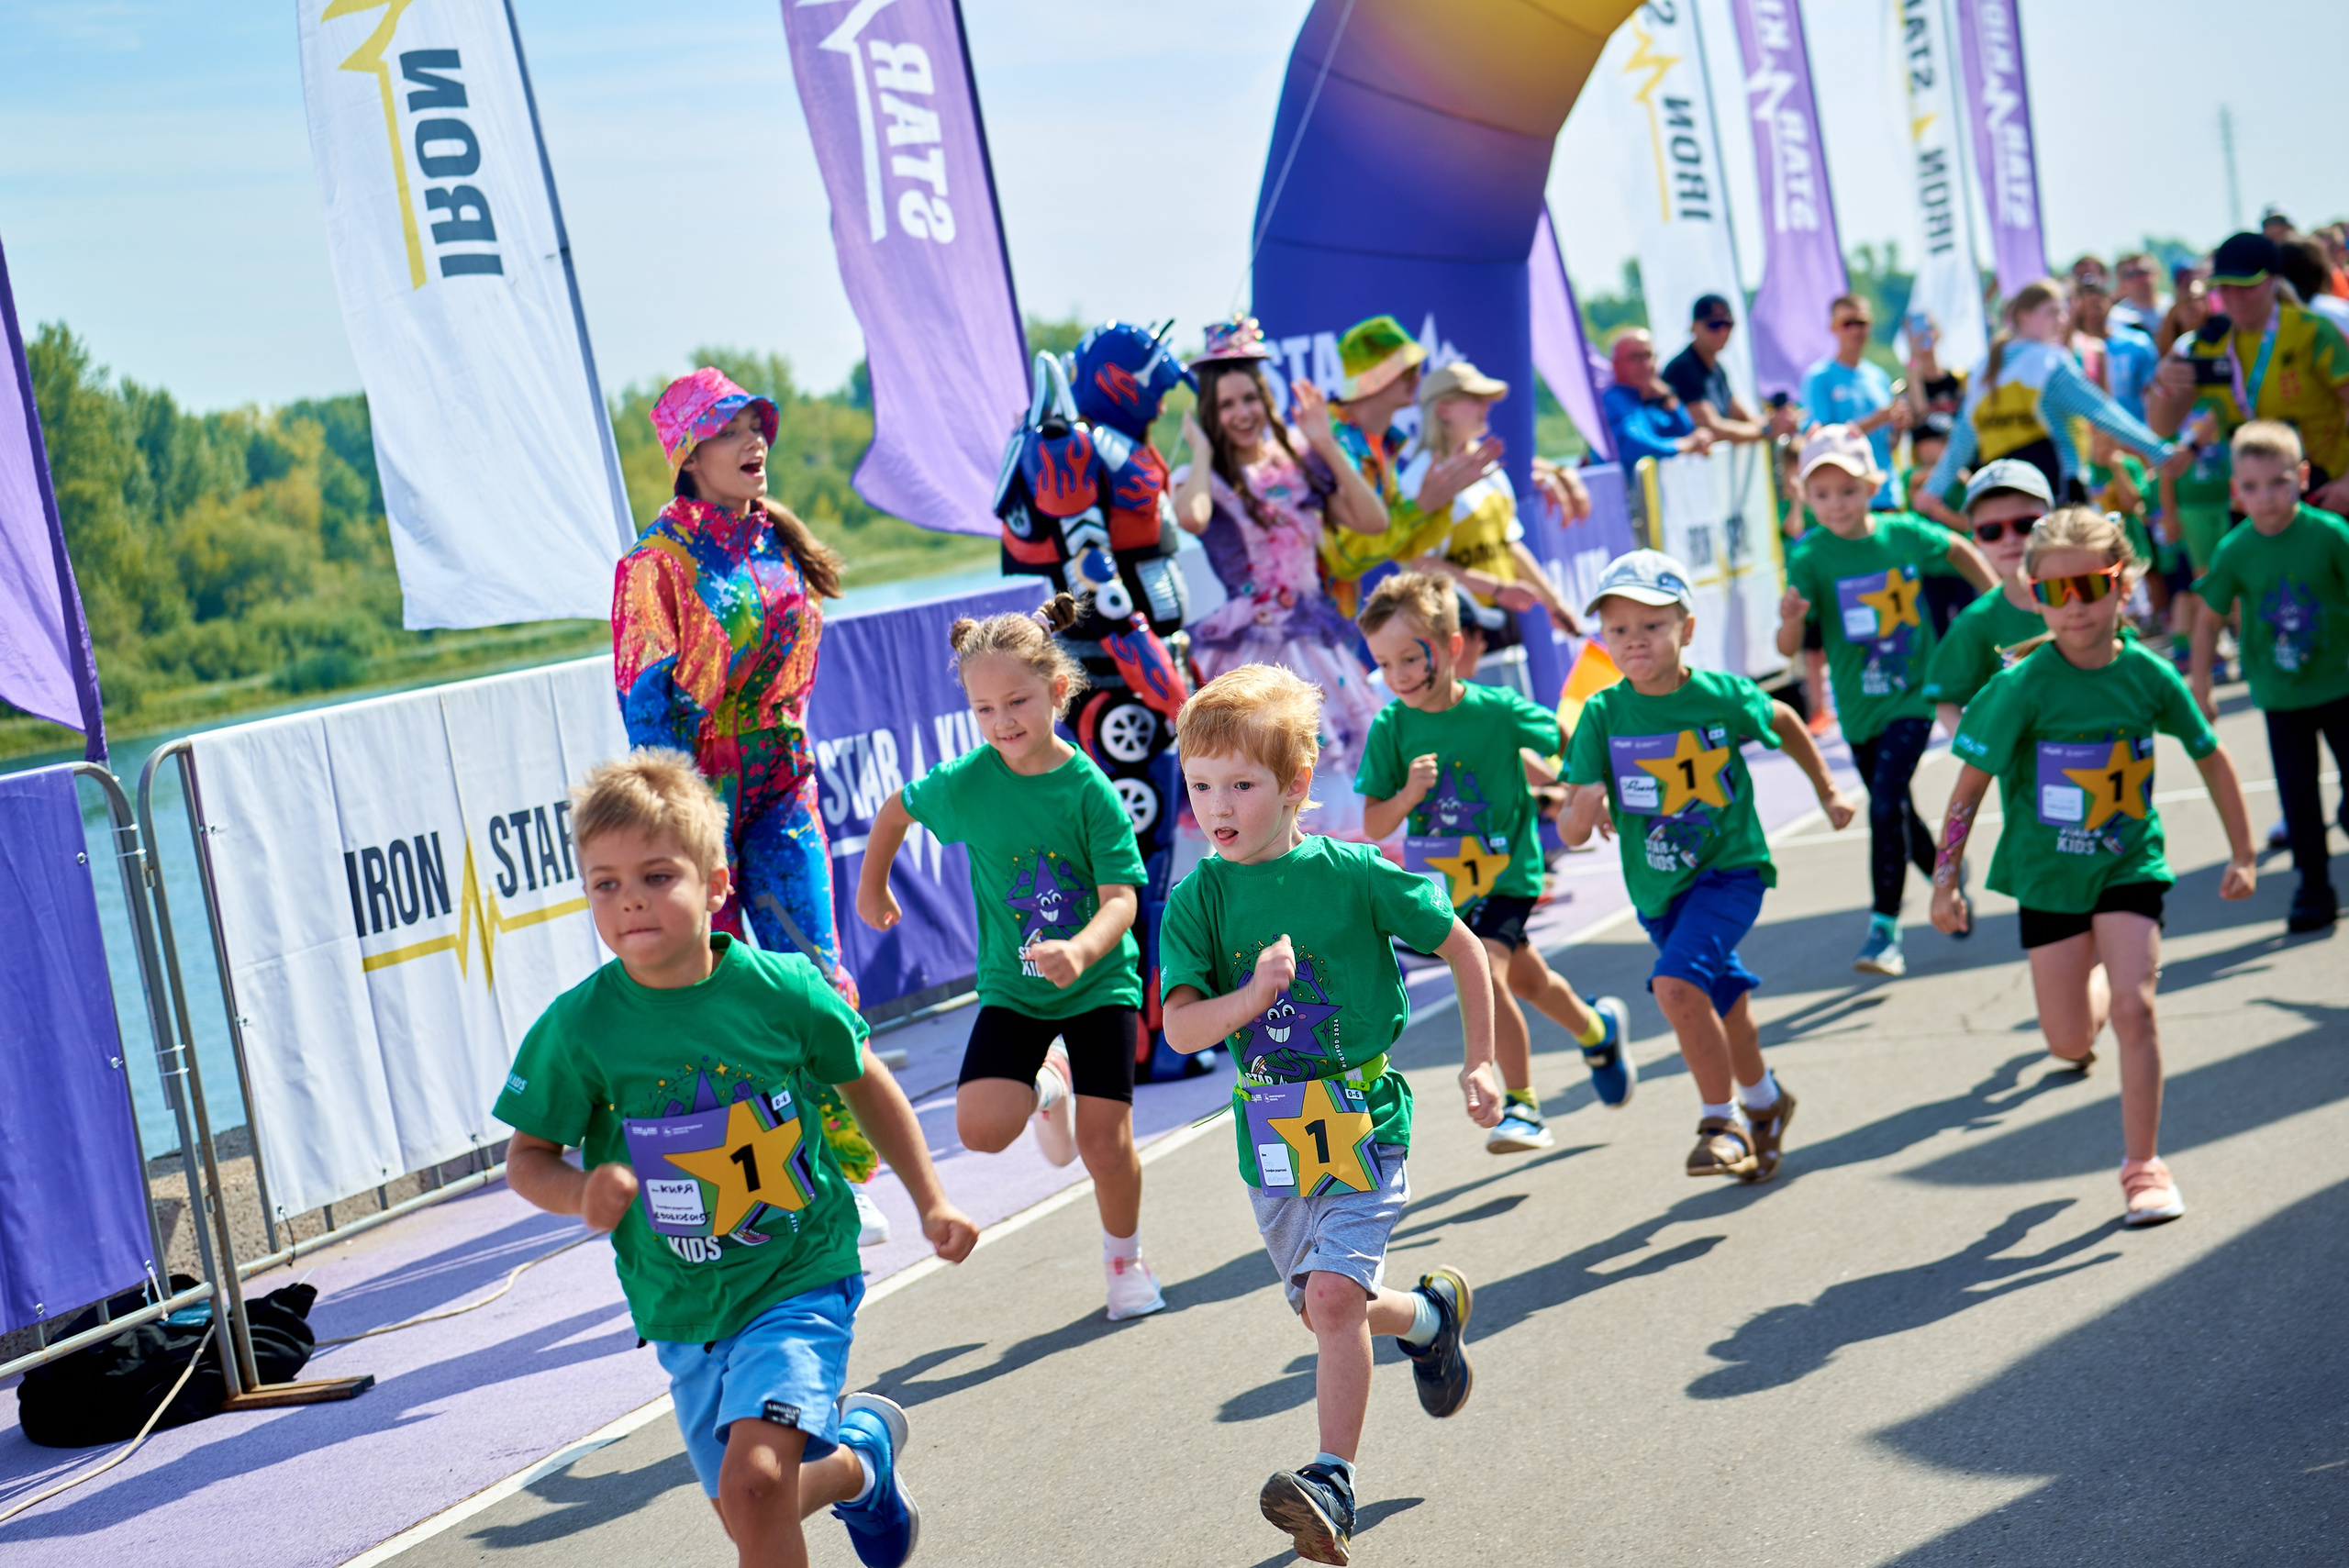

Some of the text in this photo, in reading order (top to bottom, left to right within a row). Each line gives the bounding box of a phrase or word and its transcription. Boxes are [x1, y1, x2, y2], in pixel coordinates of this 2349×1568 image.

[817, 728, 904, 825] STAR
[1677, 758, 1695, 790] 1
[2108, 770, 2124, 802] 1
[344, 831, 451, 938] IRON
[1463, 859, 1478, 886] 1
[1304, 1118, 1330, 1164] 1
[729, 1143, 762, 1193] 1
[668, 1236, 722, 1263] KIDS
